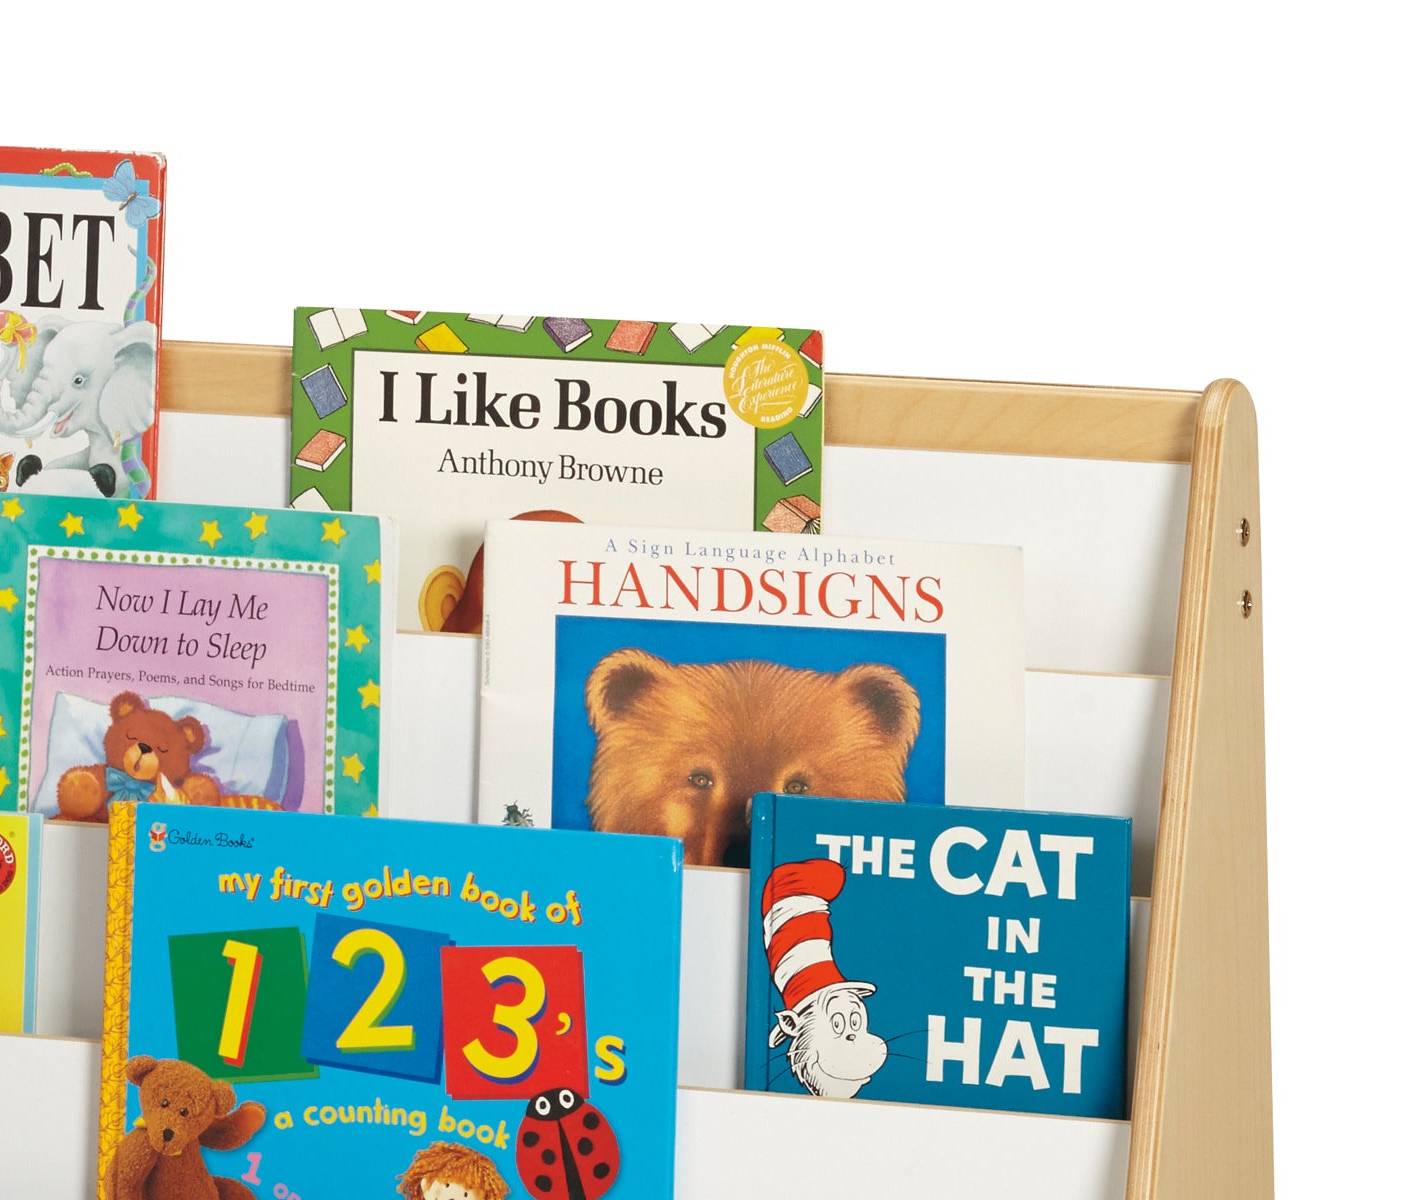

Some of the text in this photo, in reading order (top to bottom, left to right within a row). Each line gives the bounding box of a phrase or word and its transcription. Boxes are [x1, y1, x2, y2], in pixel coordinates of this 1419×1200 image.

[729, 343, 791, 378] HOUGHTON MIFFLIN
[751, 352, 775, 377] The
[379, 372, 727, 439] I Like Books
[760, 407, 793, 423] READING
[437, 449, 664, 487] Anthony Browne
[605, 538, 897, 566] A Sign Language Alphabet
[95, 585, 268, 626] Now I Lay Me
[557, 559, 945, 623] HANDSIGNS
[95, 625, 267, 669] Down to Sleep
[45, 666, 315, 693] Action Prayers, Poems, and Songs for Bedtime
[168, 829, 253, 848] Golden Books
[815, 826, 1094, 900] THE CAT
[218, 865, 583, 926] my first golden book of
[987, 916, 1040, 954] IN
[218, 939, 263, 1068] 1
[331, 928, 416, 1054] 2
[963, 966, 1057, 1009] THE
[926, 1014, 1099, 1094] HAT
[274, 1097, 510, 1149] a counting book
[241, 1152, 262, 1185] 1
